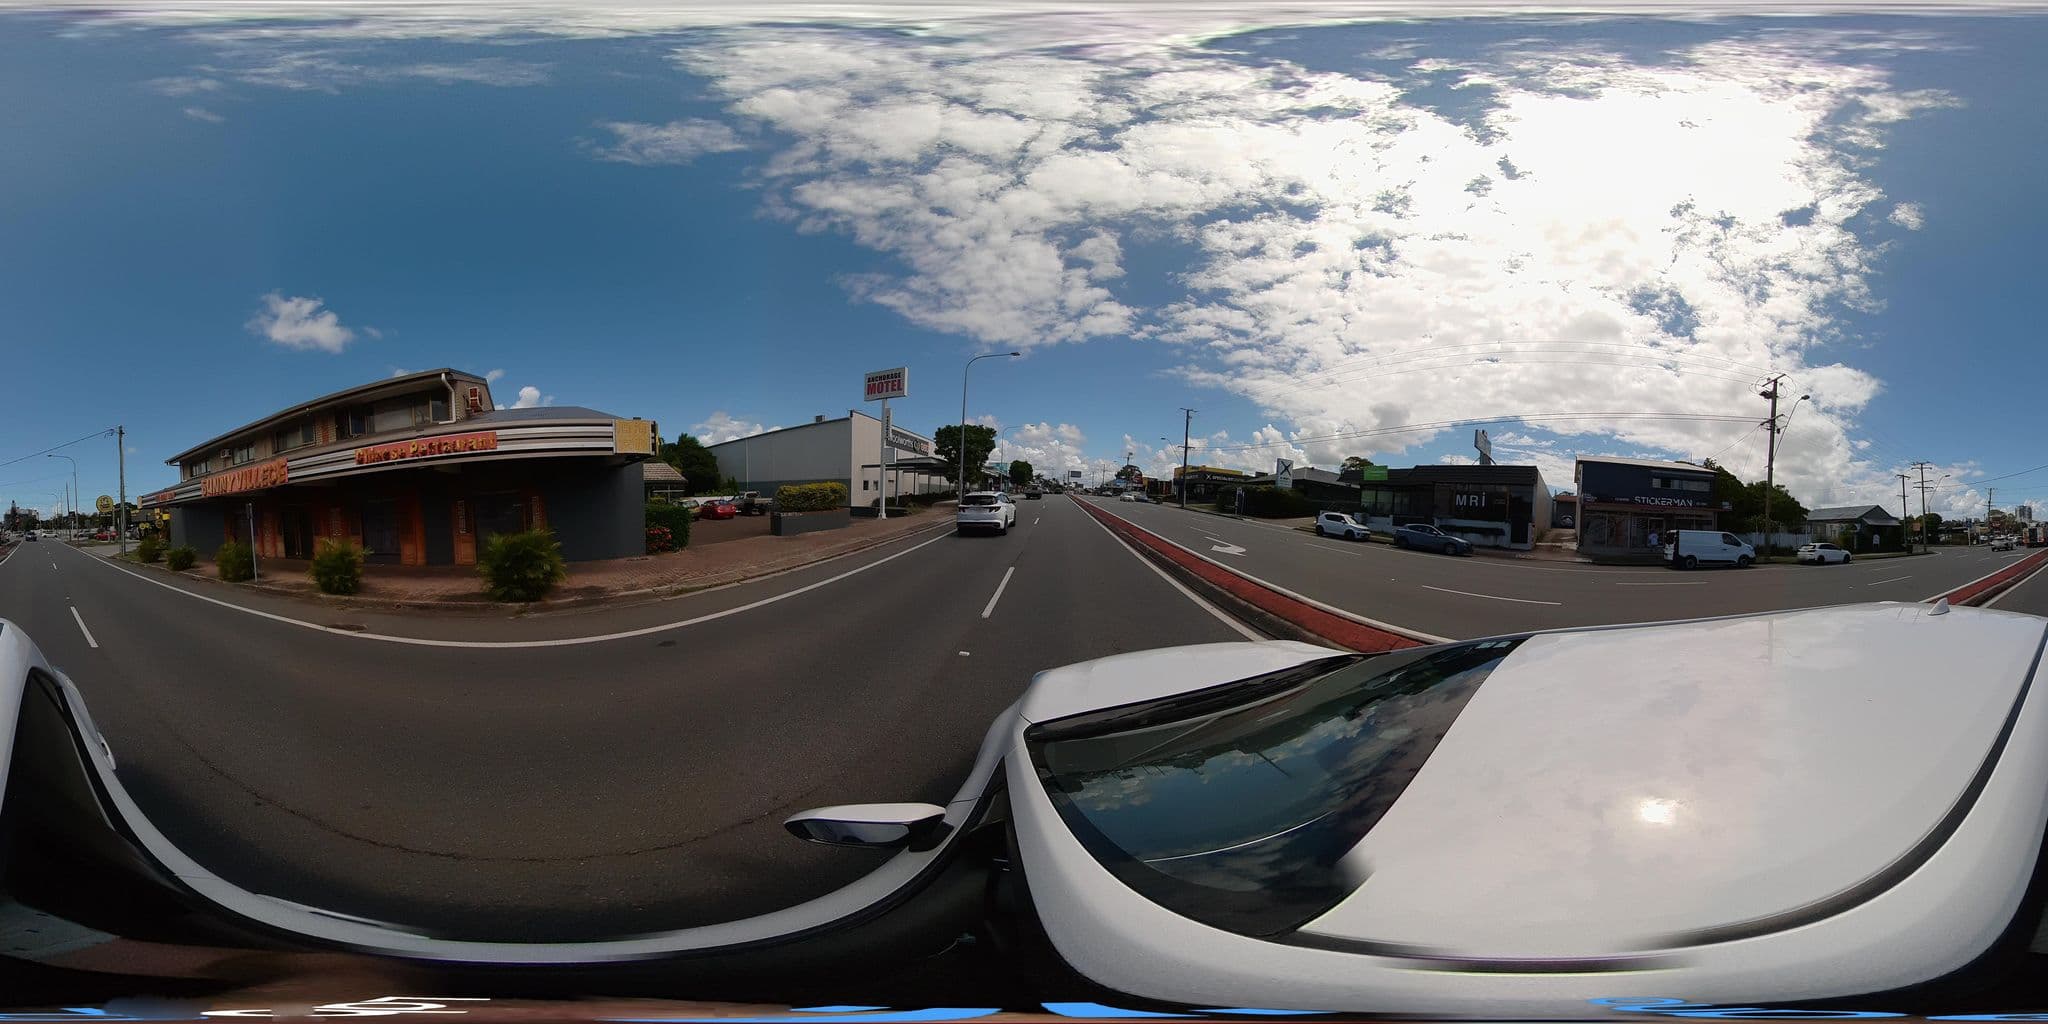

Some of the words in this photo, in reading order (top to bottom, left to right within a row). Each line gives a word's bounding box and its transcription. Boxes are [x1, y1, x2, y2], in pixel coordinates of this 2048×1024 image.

[867, 372, 902, 383] ANCHORAGE
[866, 379, 904, 396] MOTEL
[1634, 496, 1693, 507] STICKERMAN
